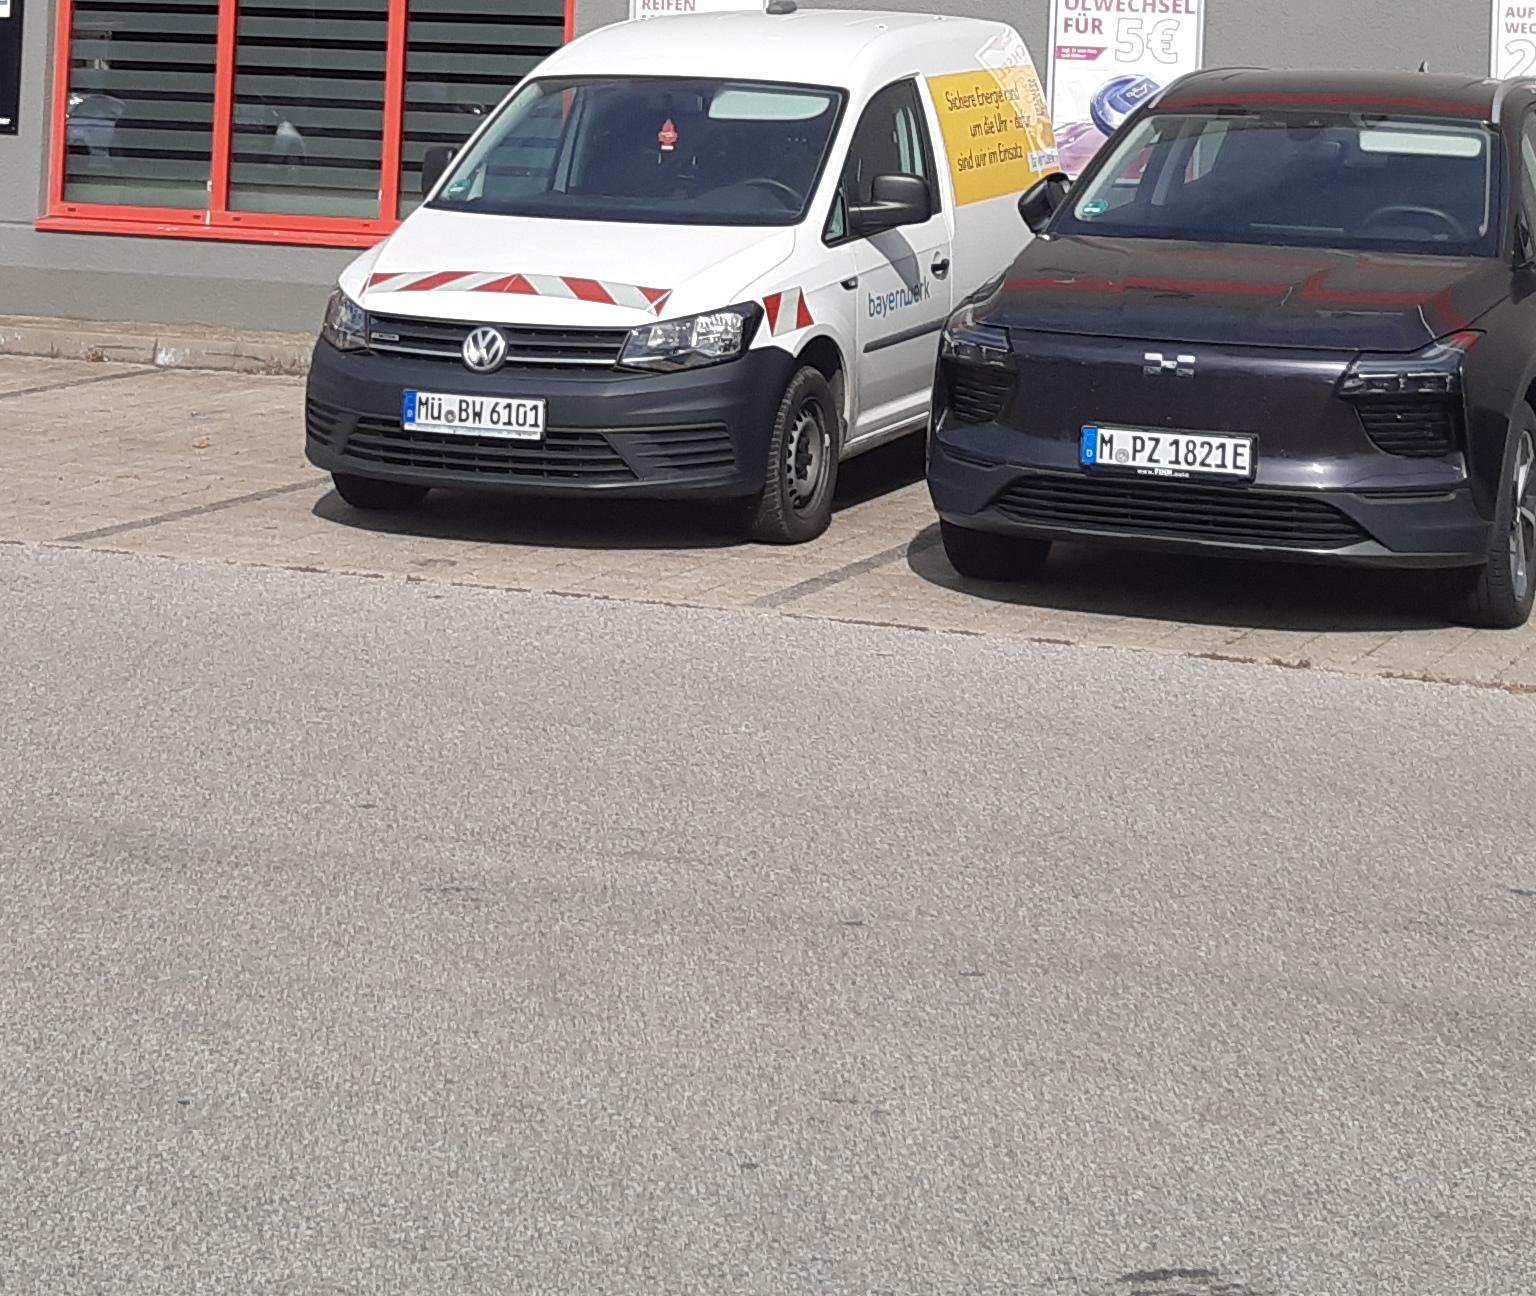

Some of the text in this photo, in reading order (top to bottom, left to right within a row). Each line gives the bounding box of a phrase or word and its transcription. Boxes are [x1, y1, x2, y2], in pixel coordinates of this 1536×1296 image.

[1505, 6, 1536, 19] AUF
[1063, 12, 1181, 64] FÜR 5€
[868, 275, 931, 318] bayernwerk
[417, 396, 541, 428] MÜ BW 6101
[1099, 433, 1247, 470] M PZ 1821E
